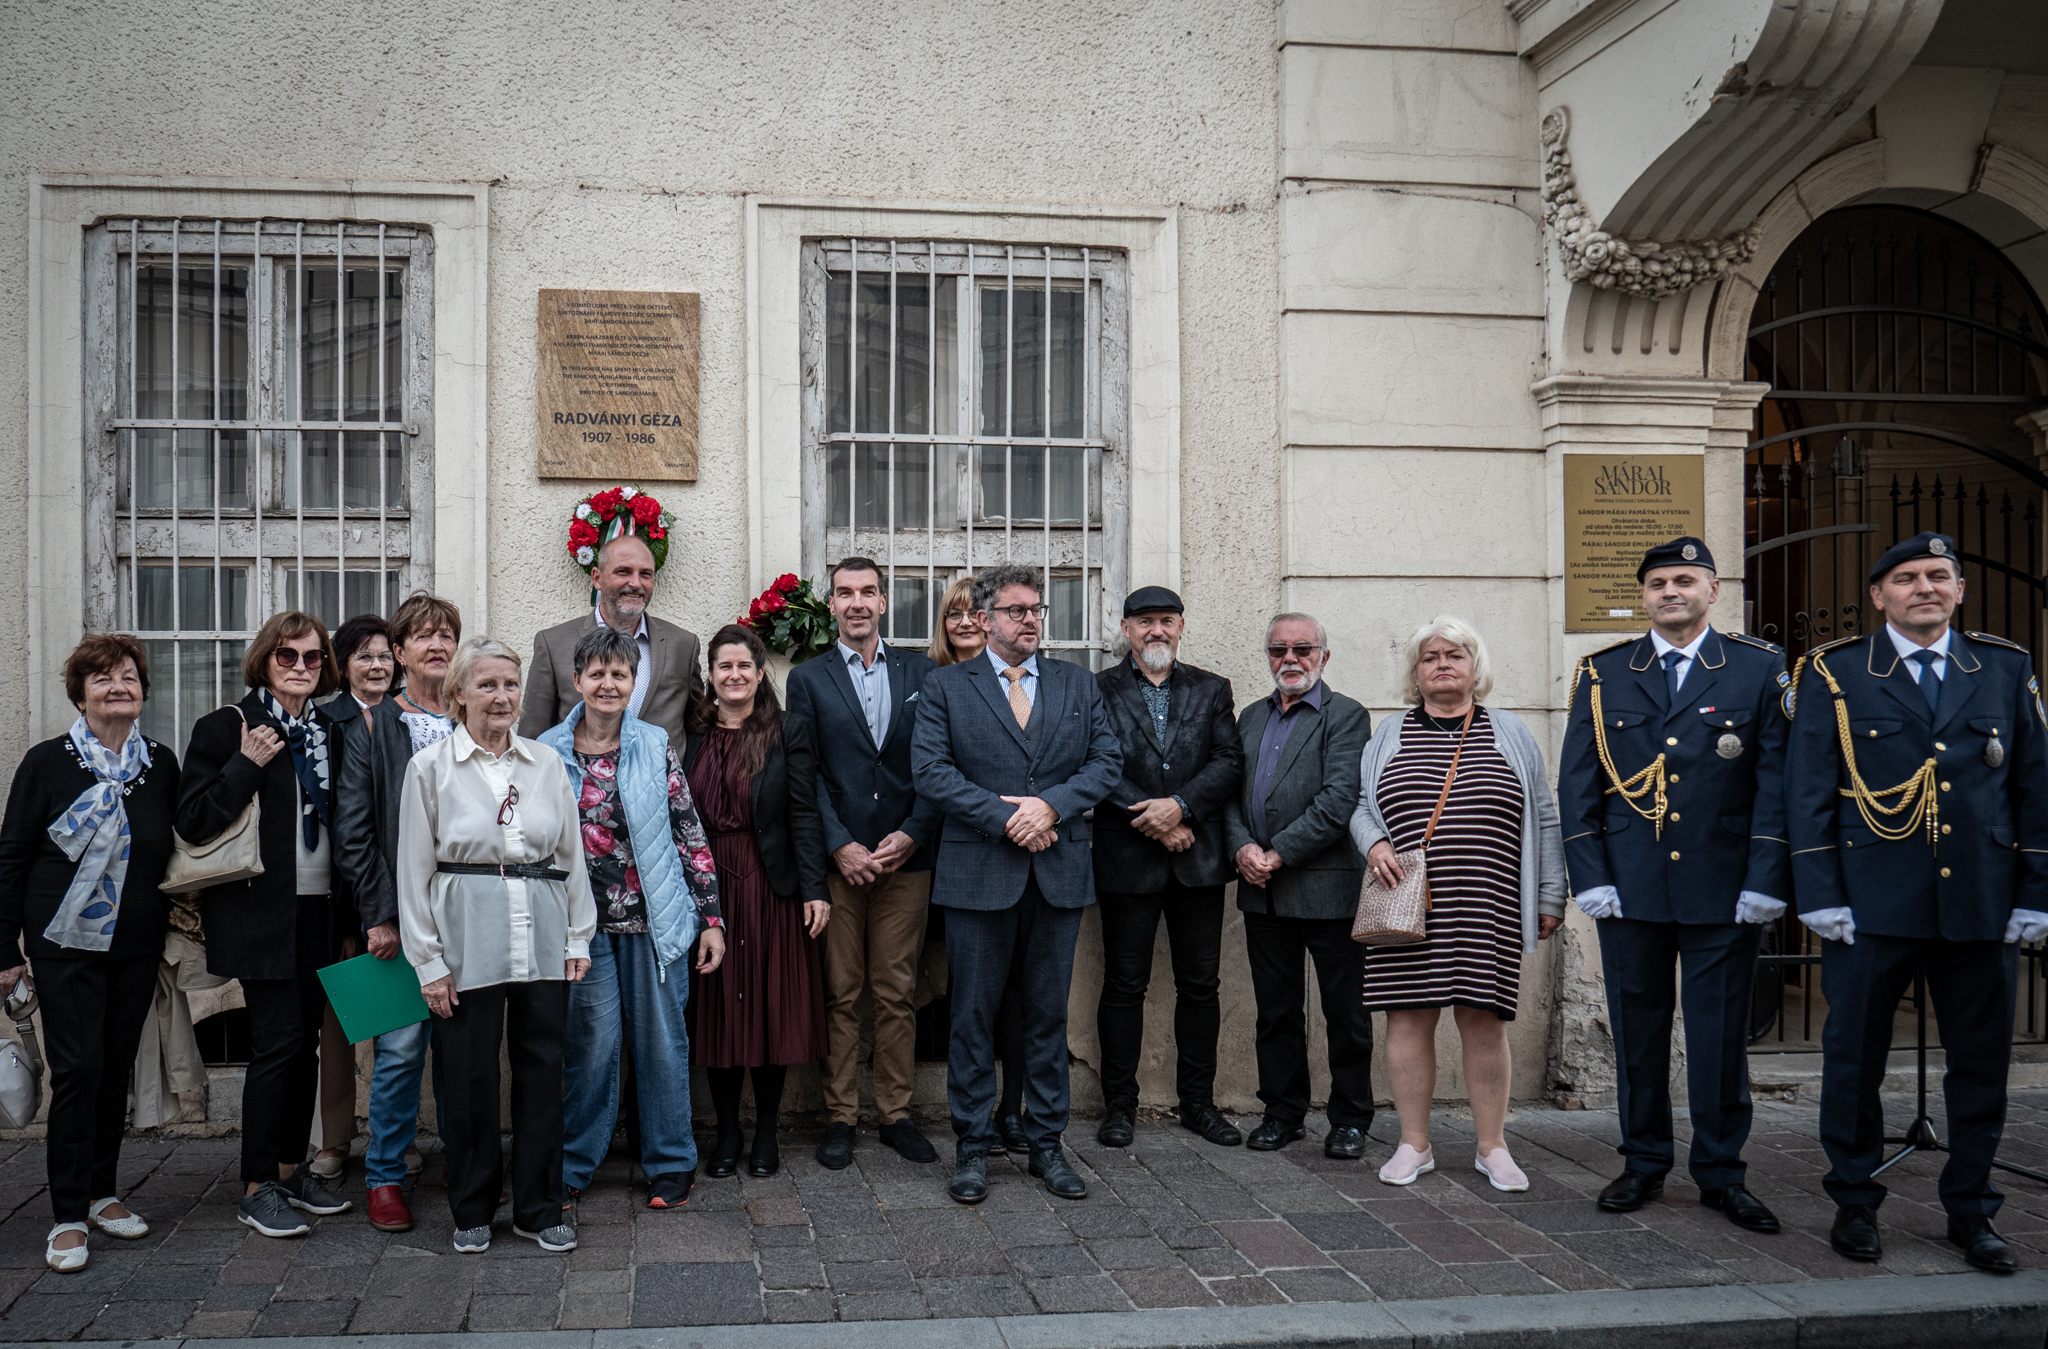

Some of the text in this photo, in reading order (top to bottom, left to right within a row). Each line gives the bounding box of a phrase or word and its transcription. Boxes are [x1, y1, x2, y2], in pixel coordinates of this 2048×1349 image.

[554, 411, 682, 427] RADVÁNYI GÉZA
[582, 432, 612, 443] 1907
[625, 433, 656, 444] 1986
[1601, 461, 1664, 485] MÁRAI
